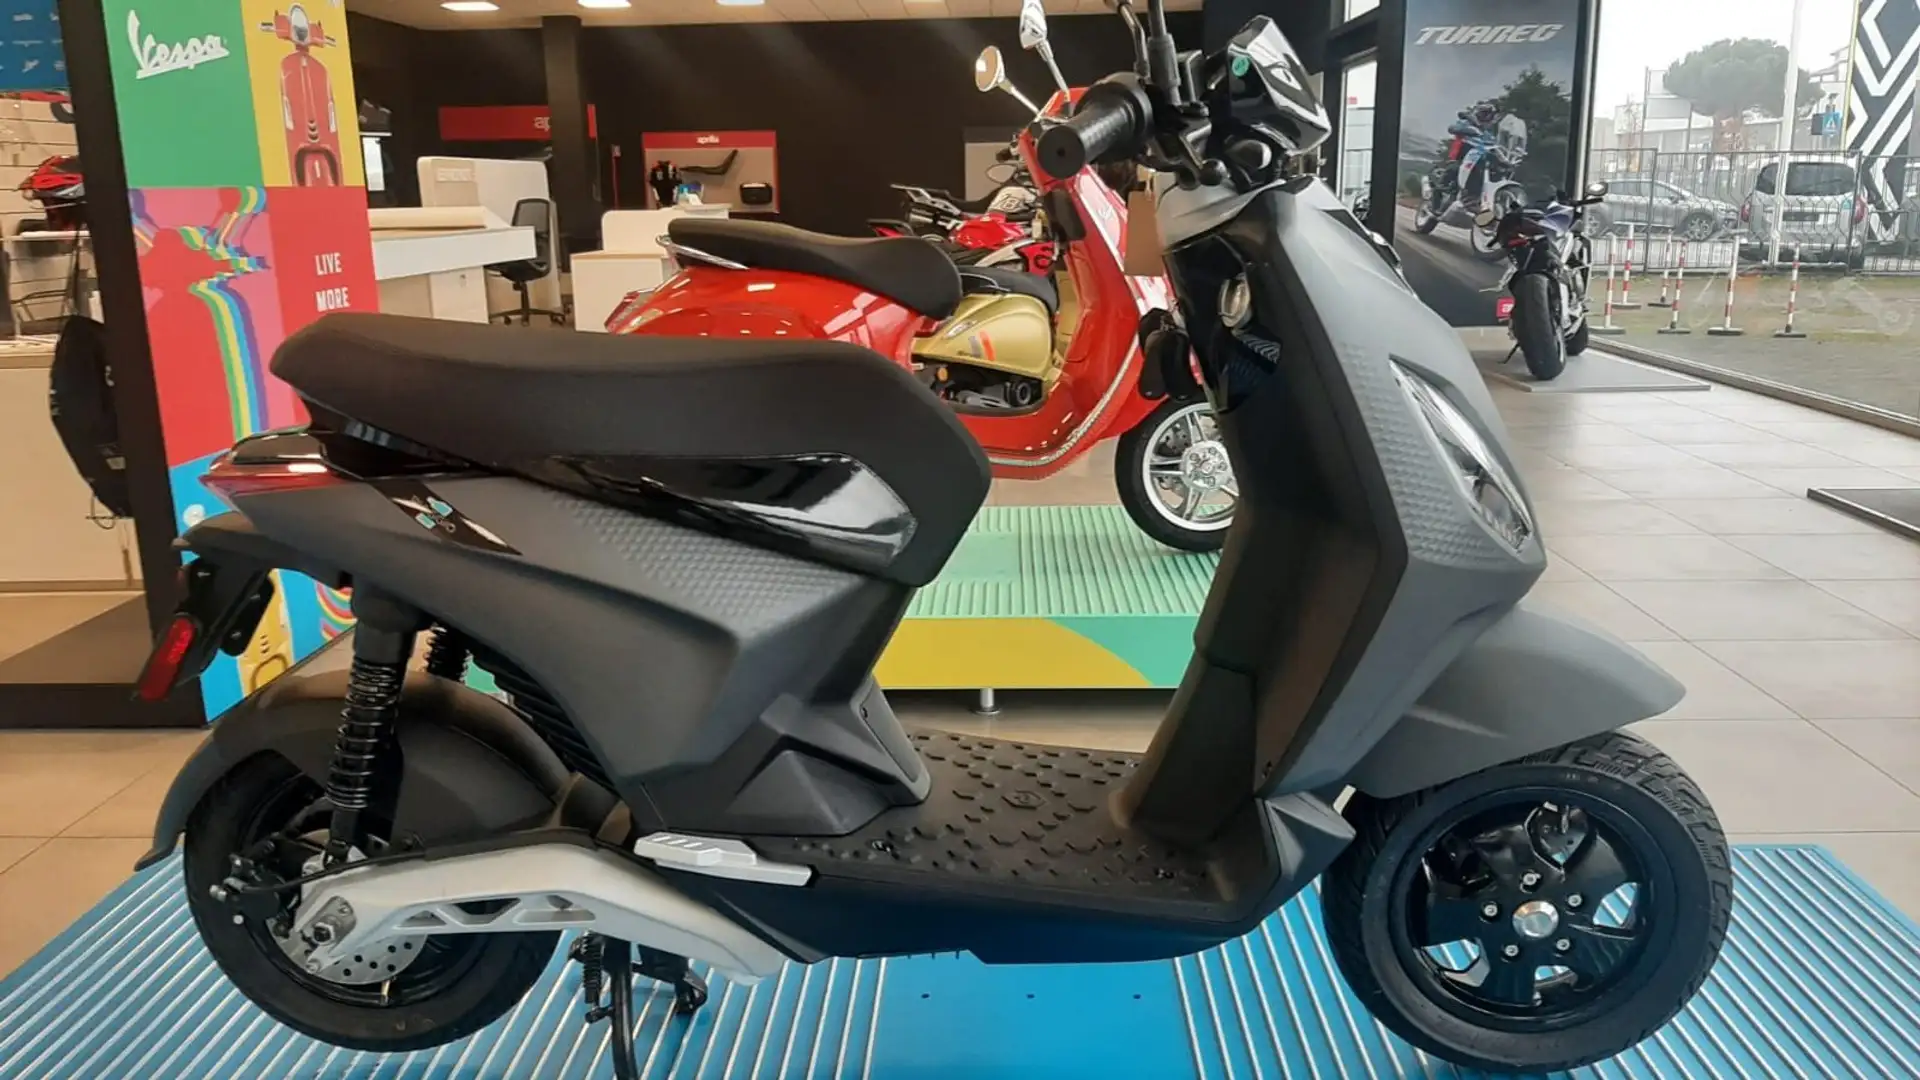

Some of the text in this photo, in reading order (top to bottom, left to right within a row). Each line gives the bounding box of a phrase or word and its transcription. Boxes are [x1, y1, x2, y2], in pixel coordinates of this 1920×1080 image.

[127, 9, 230, 79] Vespa
[1414, 24, 1565, 46] TUAREG
[315, 252, 343, 276] LIVE
[315, 286, 351, 312] MORE
